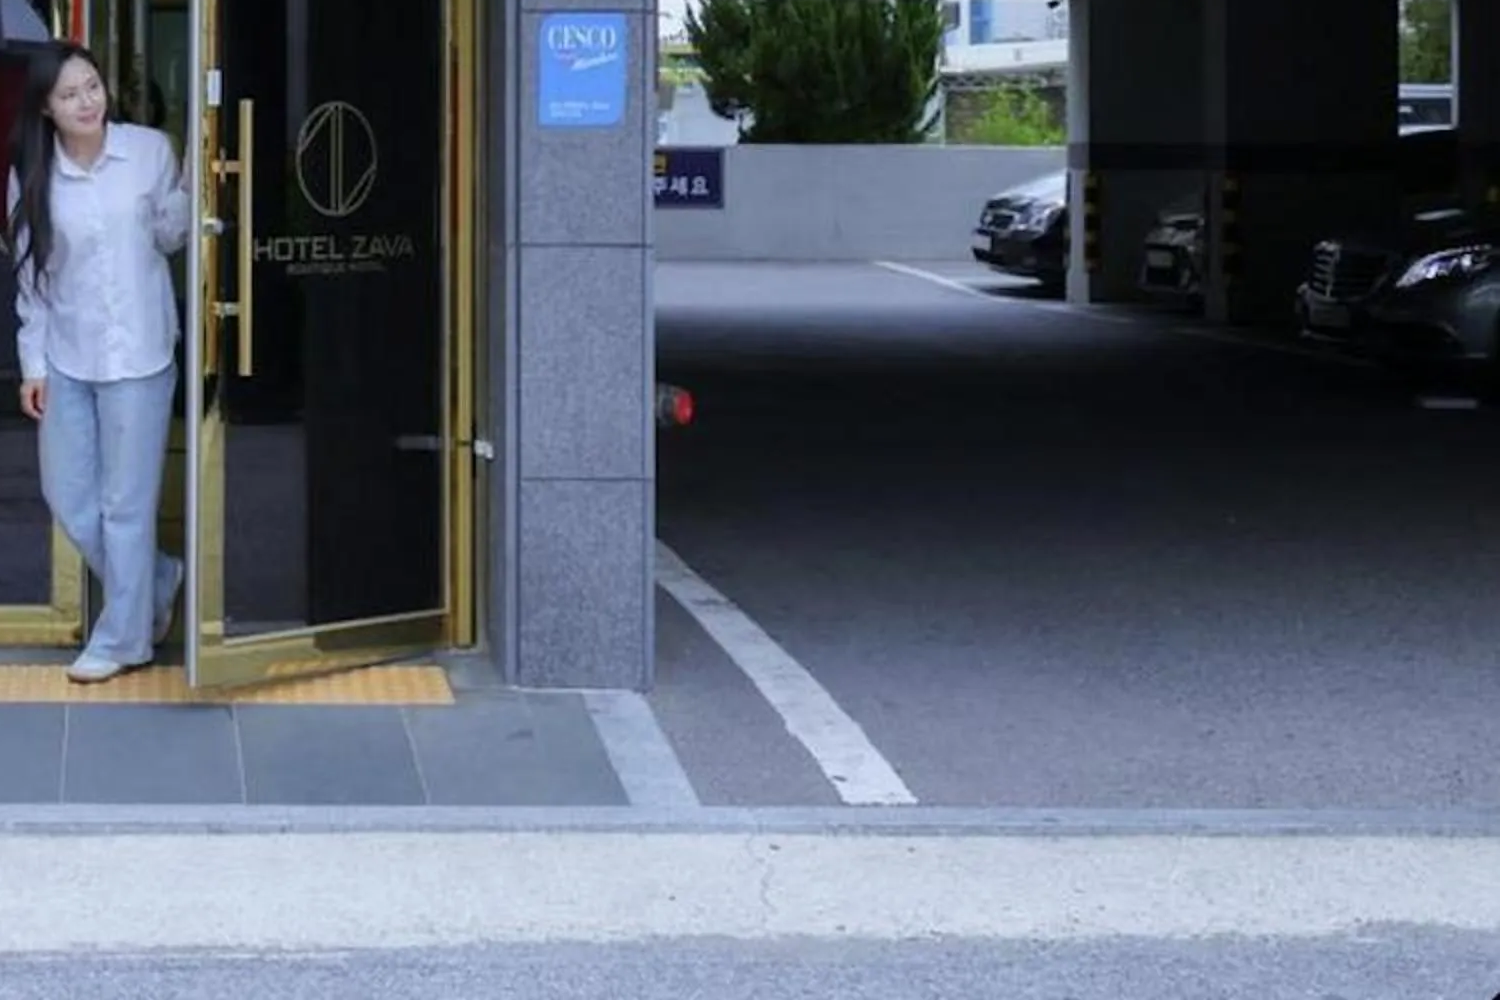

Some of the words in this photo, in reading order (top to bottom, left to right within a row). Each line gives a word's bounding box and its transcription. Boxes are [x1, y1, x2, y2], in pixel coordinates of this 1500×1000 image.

[547, 24, 617, 50] CESCO
[254, 236, 344, 261] HOTEL
[351, 234, 414, 259] ZAVA
